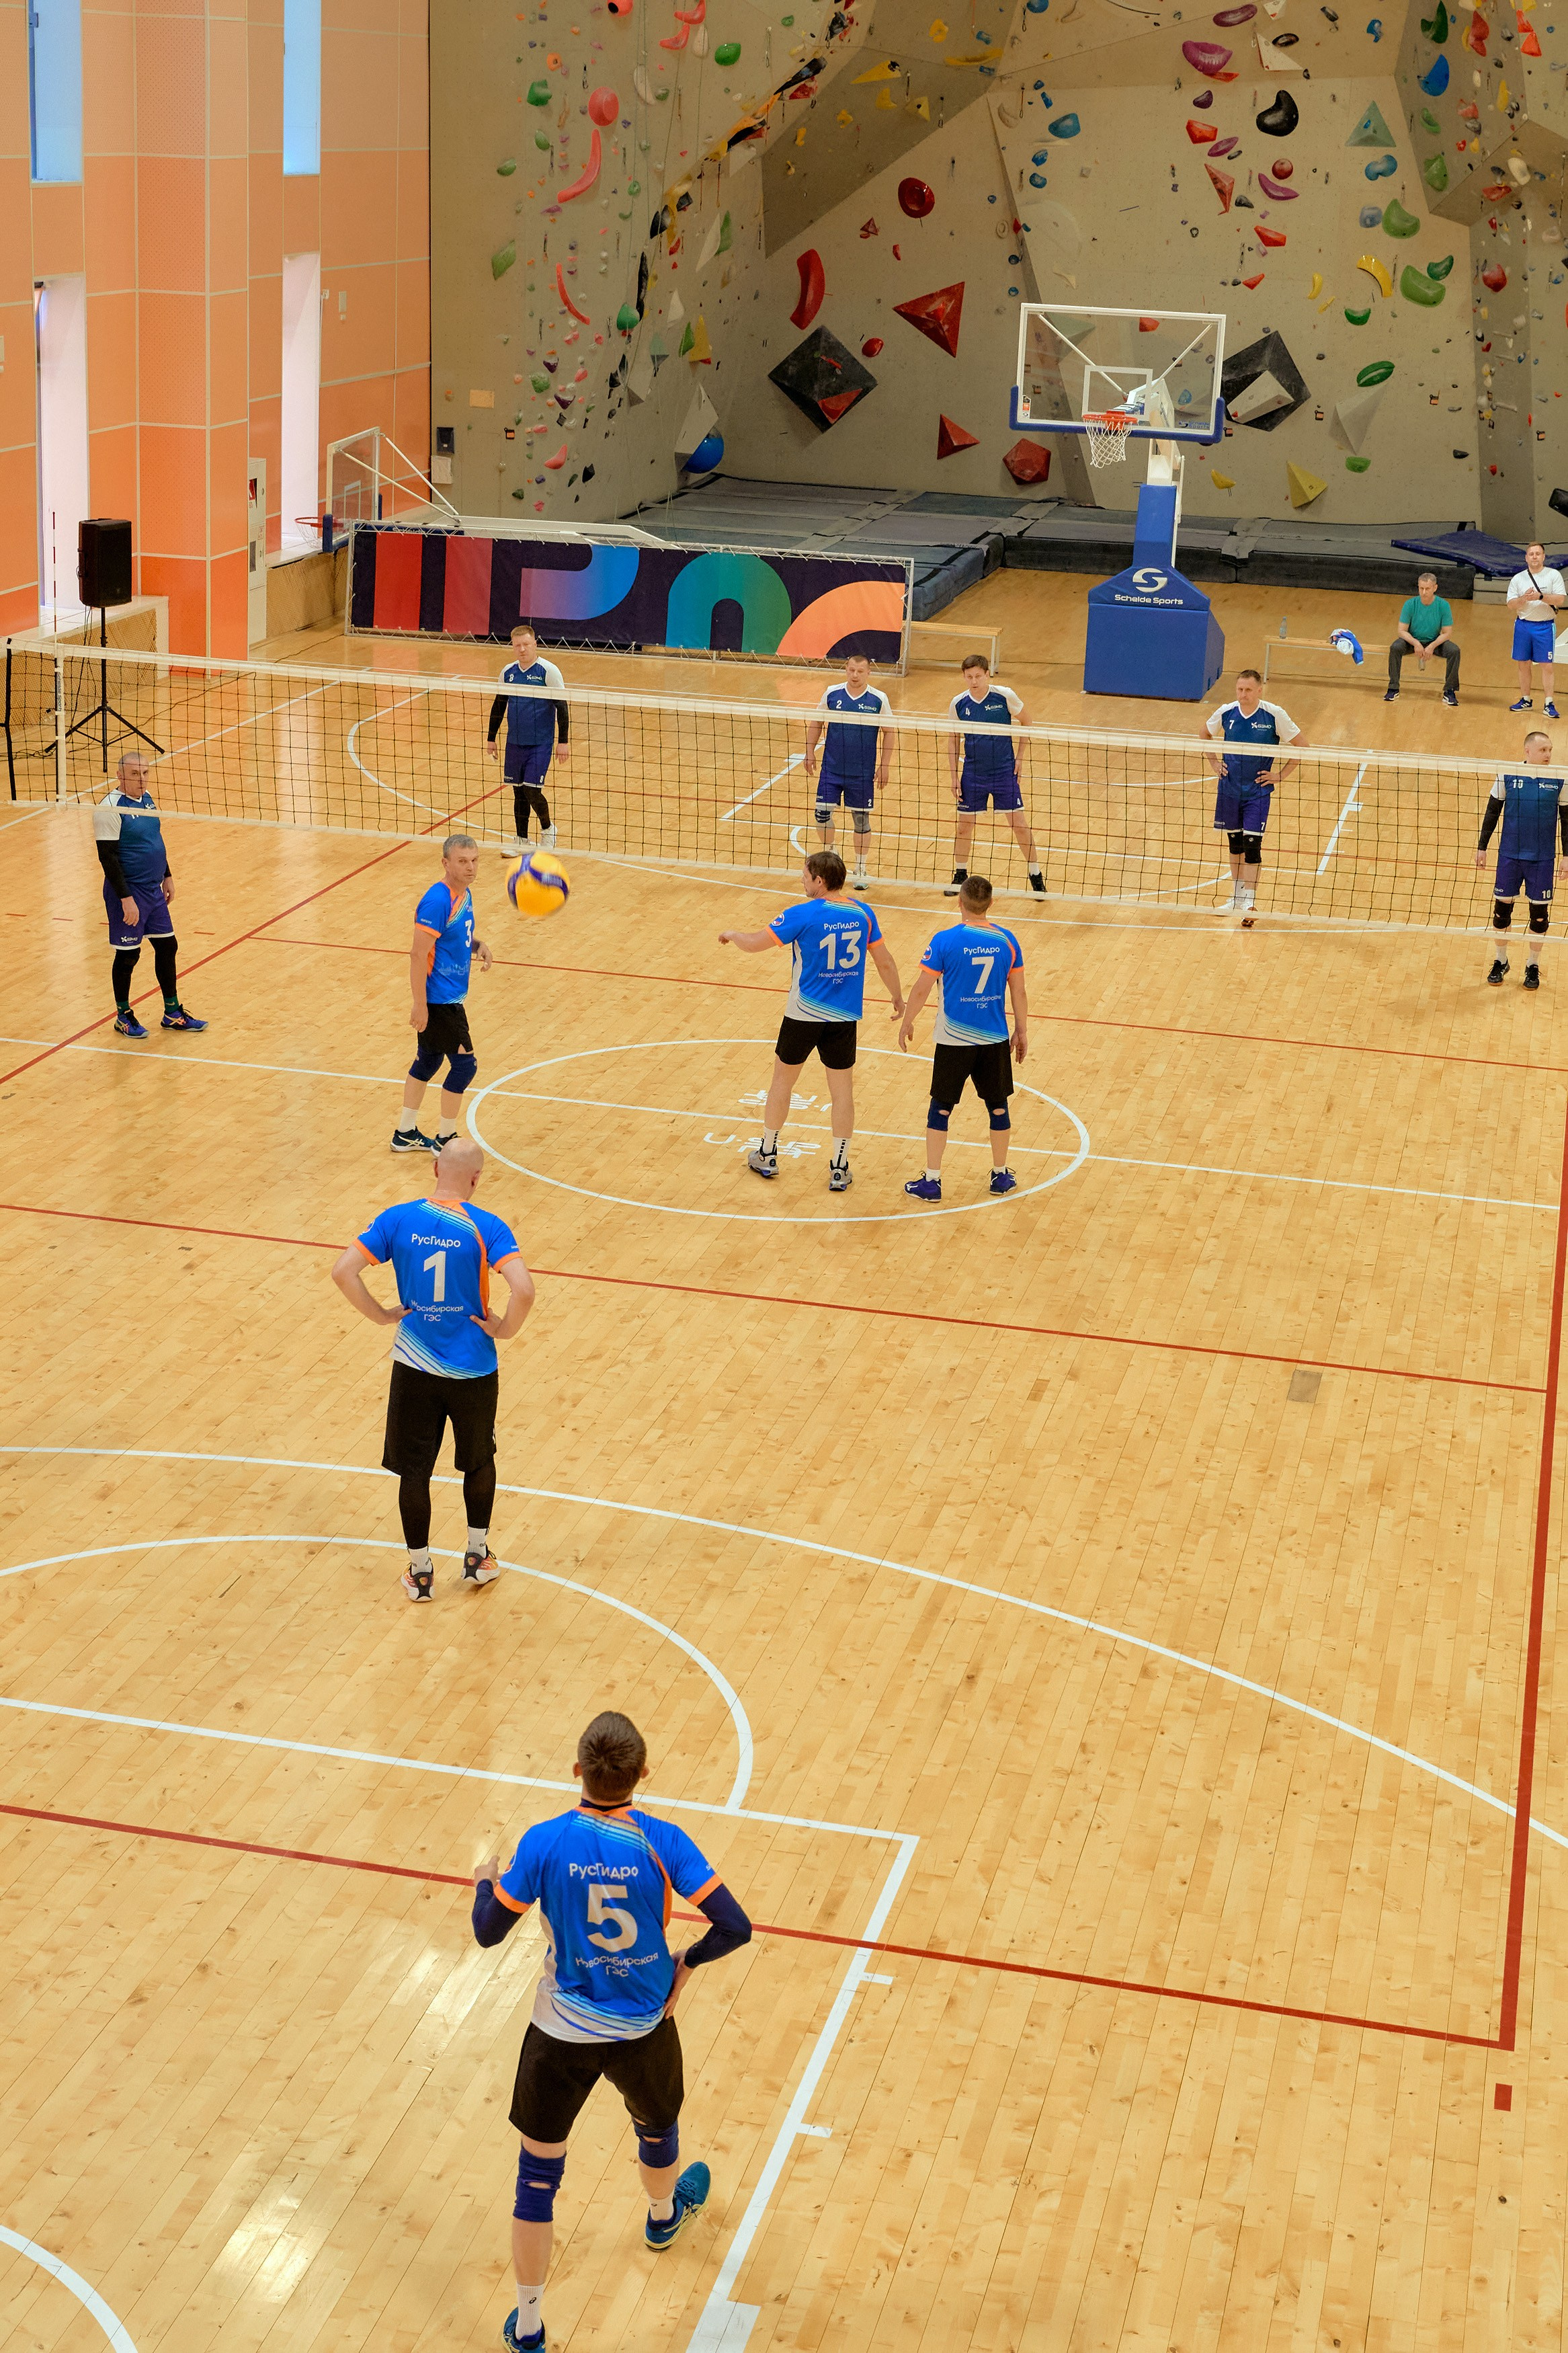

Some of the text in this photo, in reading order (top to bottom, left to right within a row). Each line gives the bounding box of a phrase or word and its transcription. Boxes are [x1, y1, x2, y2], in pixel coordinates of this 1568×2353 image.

[1114, 594, 1183, 605] Schelde Sports
[1548, 651, 1552, 660] 5
[509, 674, 514, 682] 8
[836, 700, 842, 709] 2
[966, 707, 971, 716] 4
[1229, 719, 1235, 729] 7
[540, 775, 544, 783] 8
[1513, 779, 1524, 789] 10
[868, 799, 872, 807] 2
[1261, 822, 1265, 830] 7
[1542, 890, 1551, 899] 10
[824, 921, 860, 931] РусГидро
[465, 920, 472, 947] 3
[819, 930, 862, 969] 13
[963, 947, 1000, 955] РусГидро
[972, 956, 994, 994] 7
[411, 1234, 461, 1248] РусГидро
[423, 1250, 446, 1302] 1
[411, 1300, 464, 1313] Носибирская
[569, 1863, 638, 1879] РусГидро
[587, 1883, 638, 1953] 5
[606, 1966, 628, 1977] ГЭС
